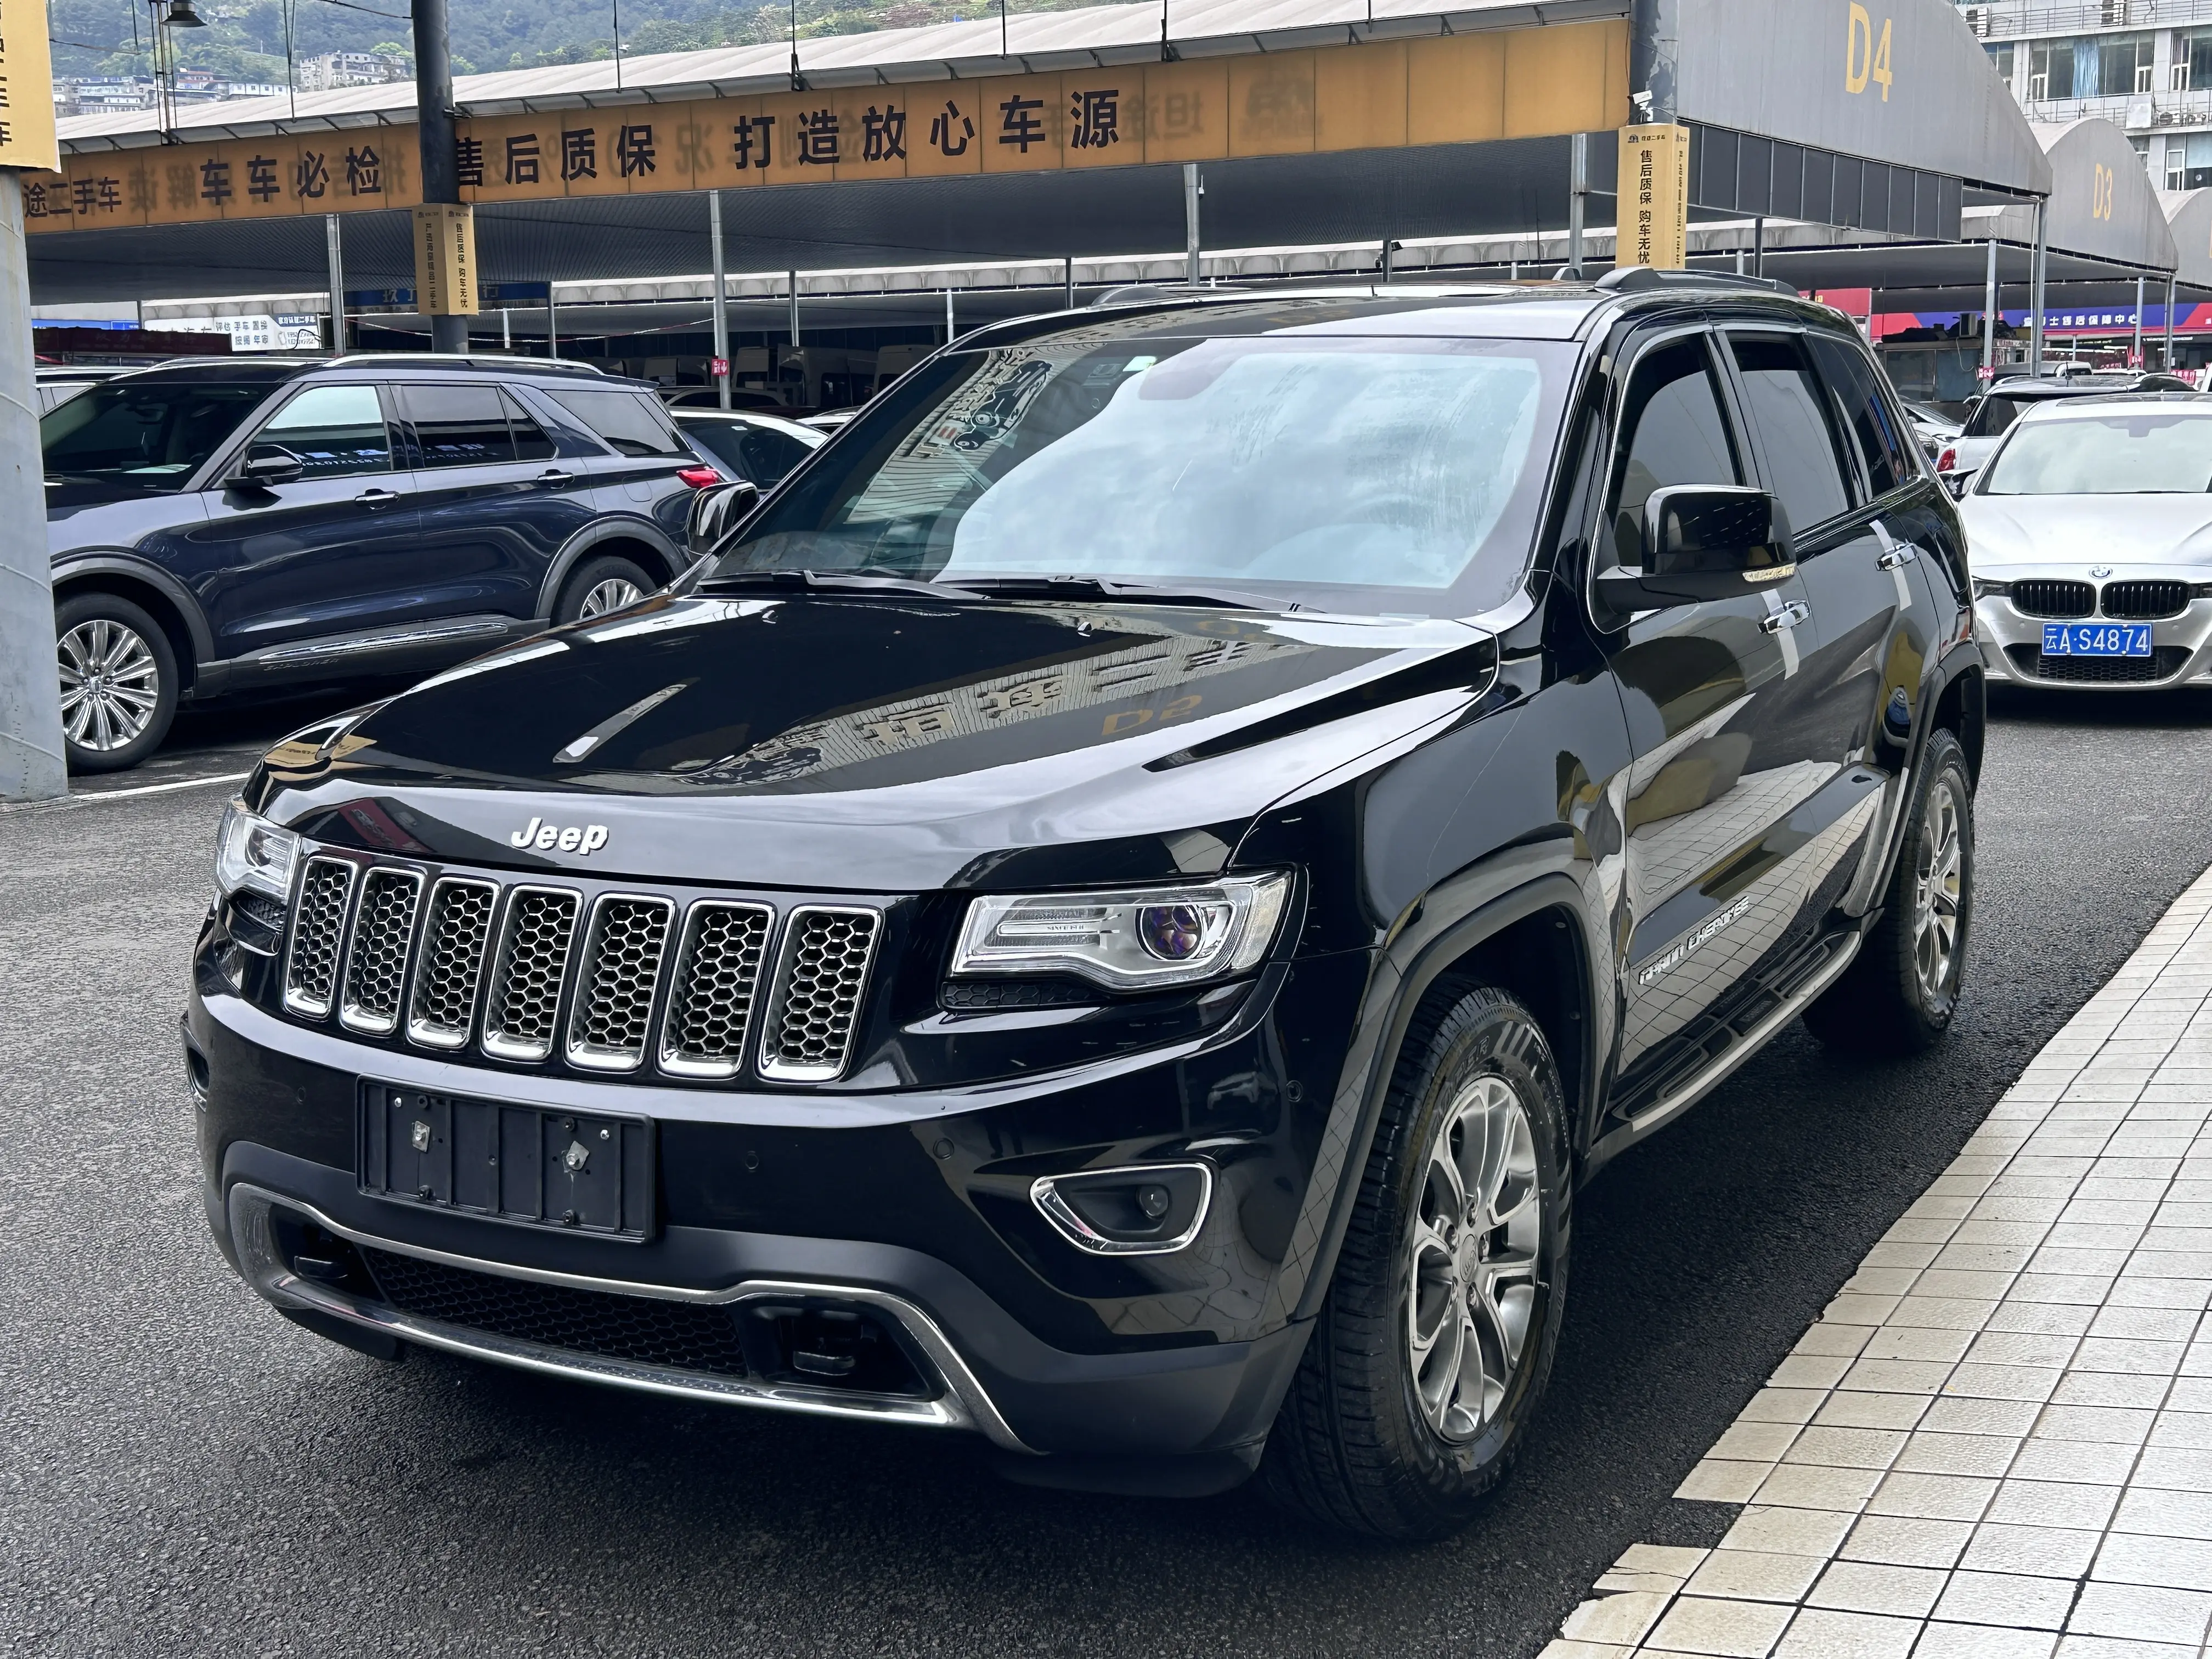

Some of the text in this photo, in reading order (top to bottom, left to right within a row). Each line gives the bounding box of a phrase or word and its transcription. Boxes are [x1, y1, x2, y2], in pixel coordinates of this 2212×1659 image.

[1846, 1, 1893, 103] D4
[200, 146, 381, 206] 车车必检
[456, 125, 657, 187] 售后质保
[733, 89, 1119, 170] 打造放心车源
[2093, 163, 2113, 221] D3
[1638, 150, 1652, 264] 售后质保 购车无忧
[511, 817, 610, 856] Jeep
